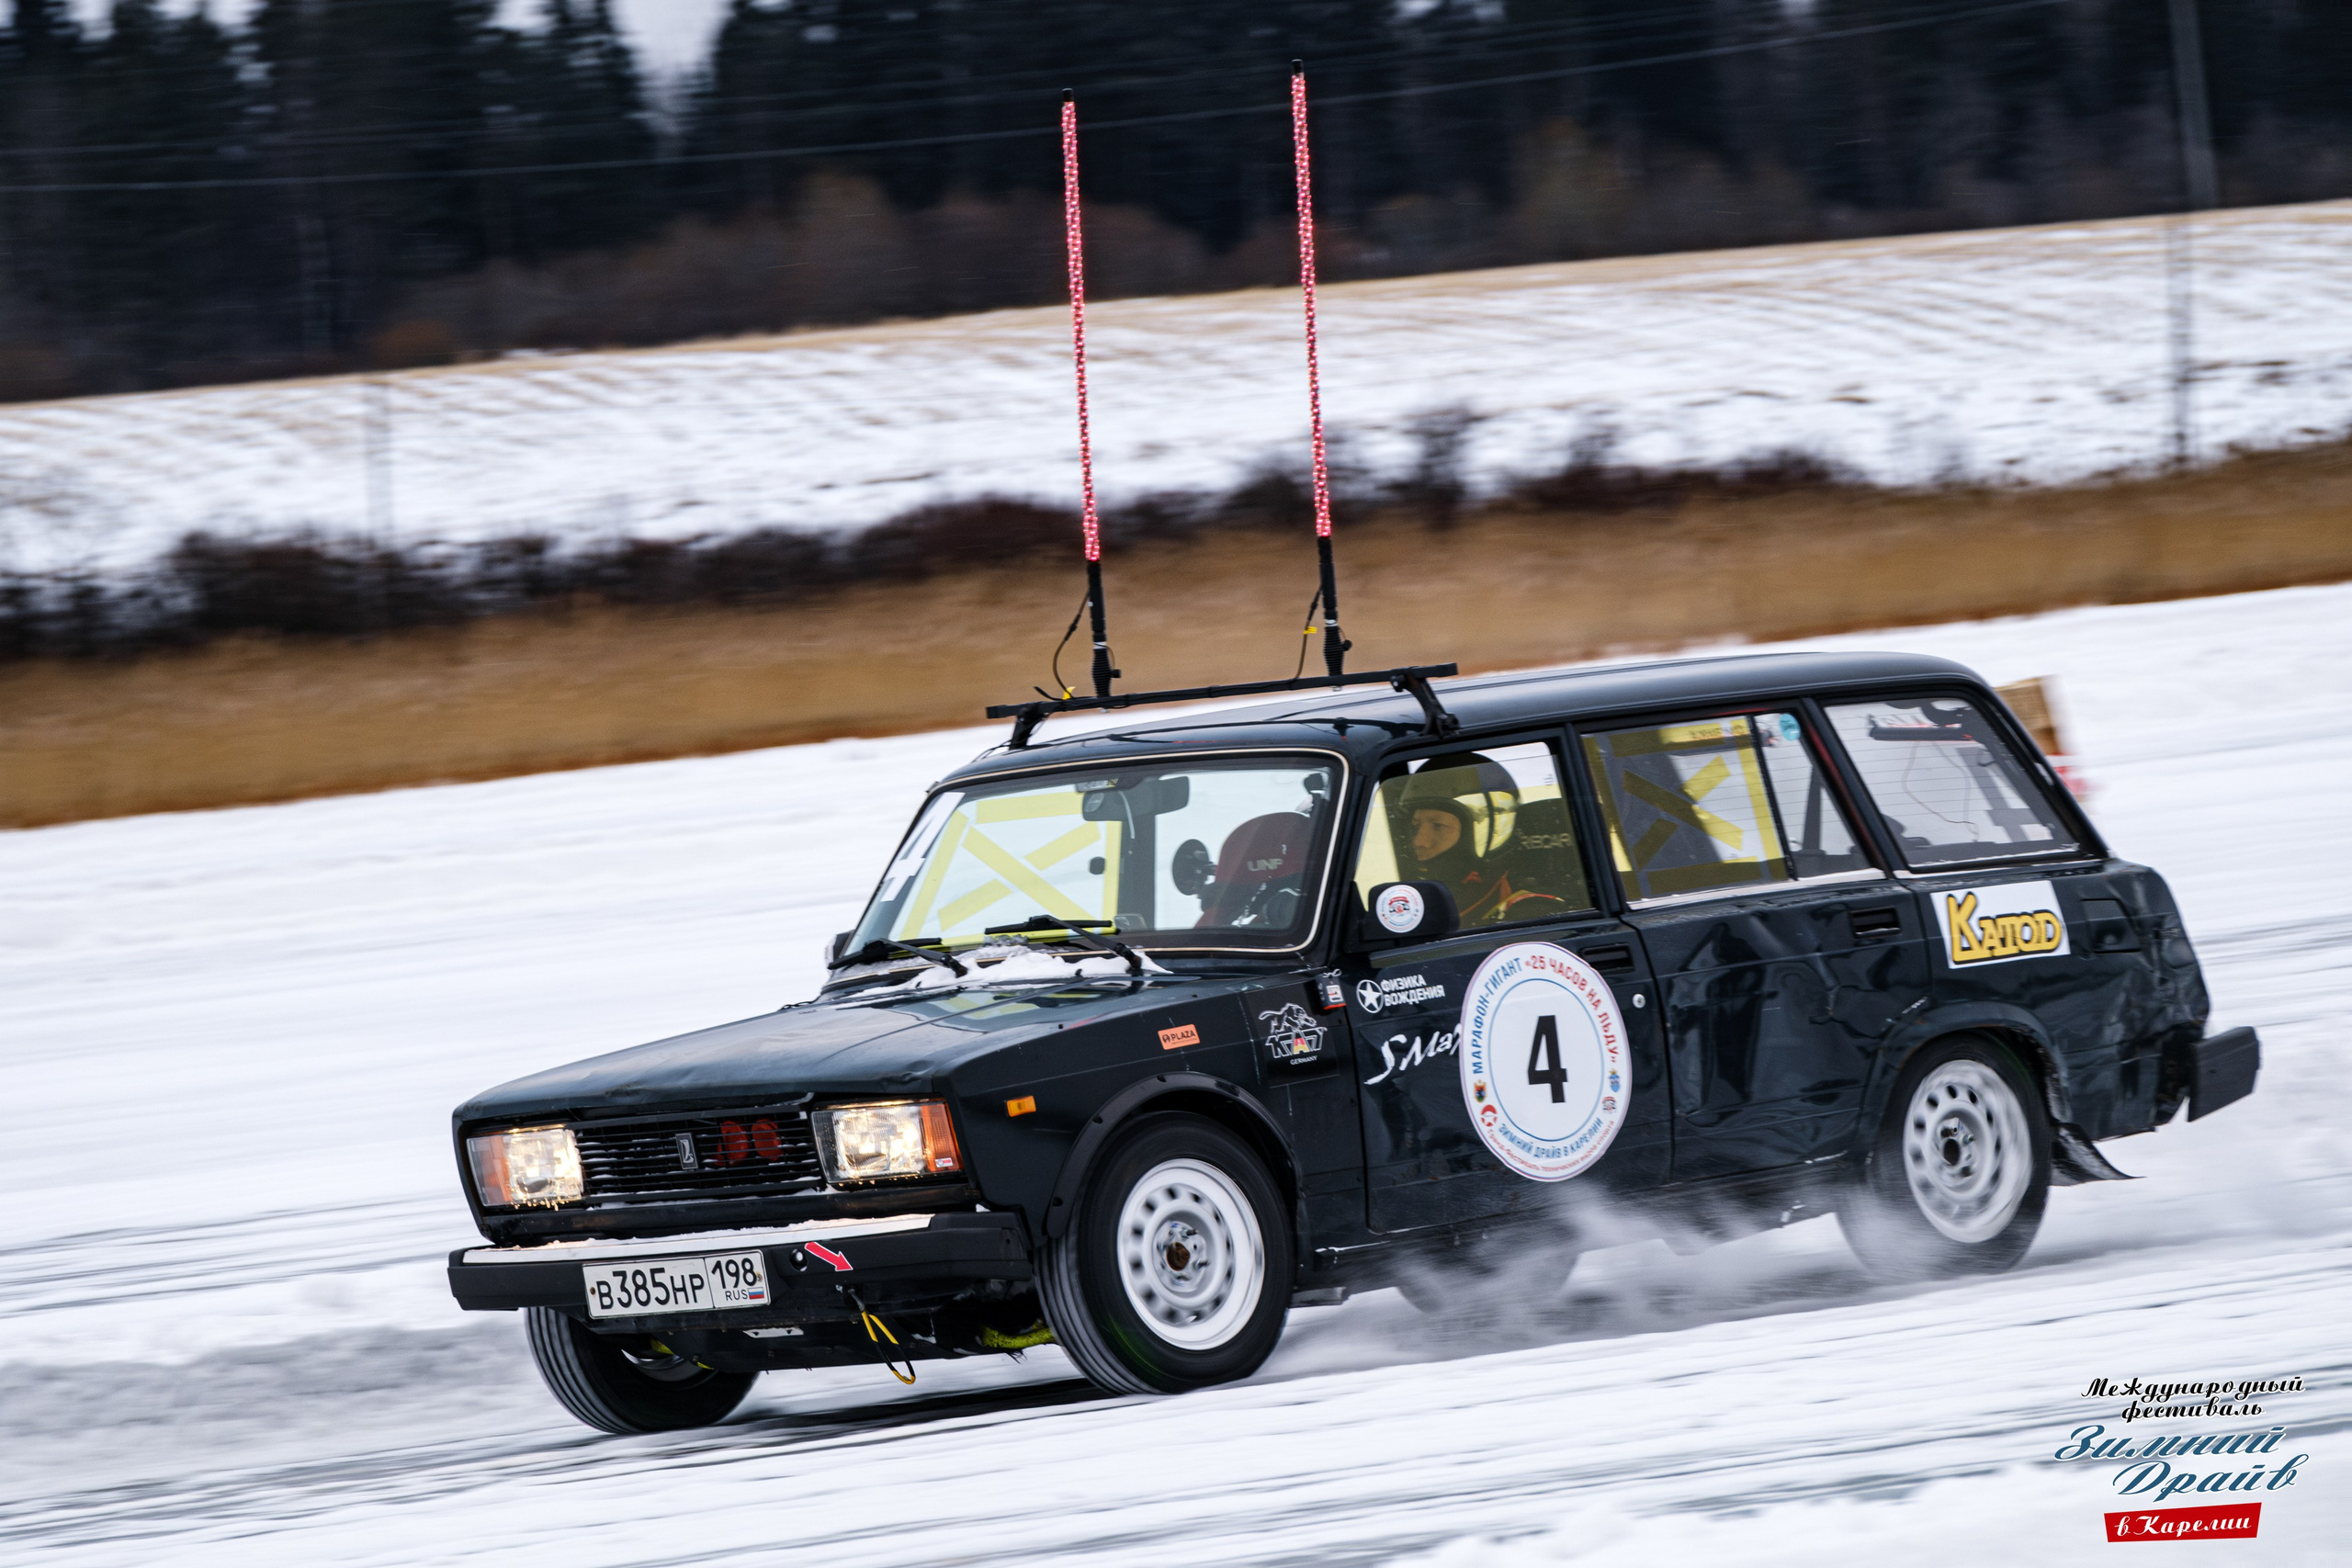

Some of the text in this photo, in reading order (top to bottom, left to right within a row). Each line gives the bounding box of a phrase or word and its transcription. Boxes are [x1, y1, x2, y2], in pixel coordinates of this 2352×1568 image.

[1380, 974, 1427, 992] ФИЗИКА
[1385, 985, 1446, 1007] ВОЖДЕНИЯ
[1471, 957, 1522, 1075] МАРАФОН-ГИГАНТ
[1549, 958, 1589, 992] ЧАСОВ
[1586, 988, 1602, 1011] НА
[1170, 1030, 1196, 1041] PLAZA
[1290, 1055, 1317, 1066] GERMANY
[1527, 1015, 1568, 1104] 4
[1498, 1122, 1532, 1156] ЗИМНИЙ
[1533, 1145, 1562, 1159] ДРАЙВ
[1570, 1117, 1604, 1156] КАРЕЛИИ
[711, 1258, 757, 1290] 198
[725, 1289, 749, 1301] RUS
